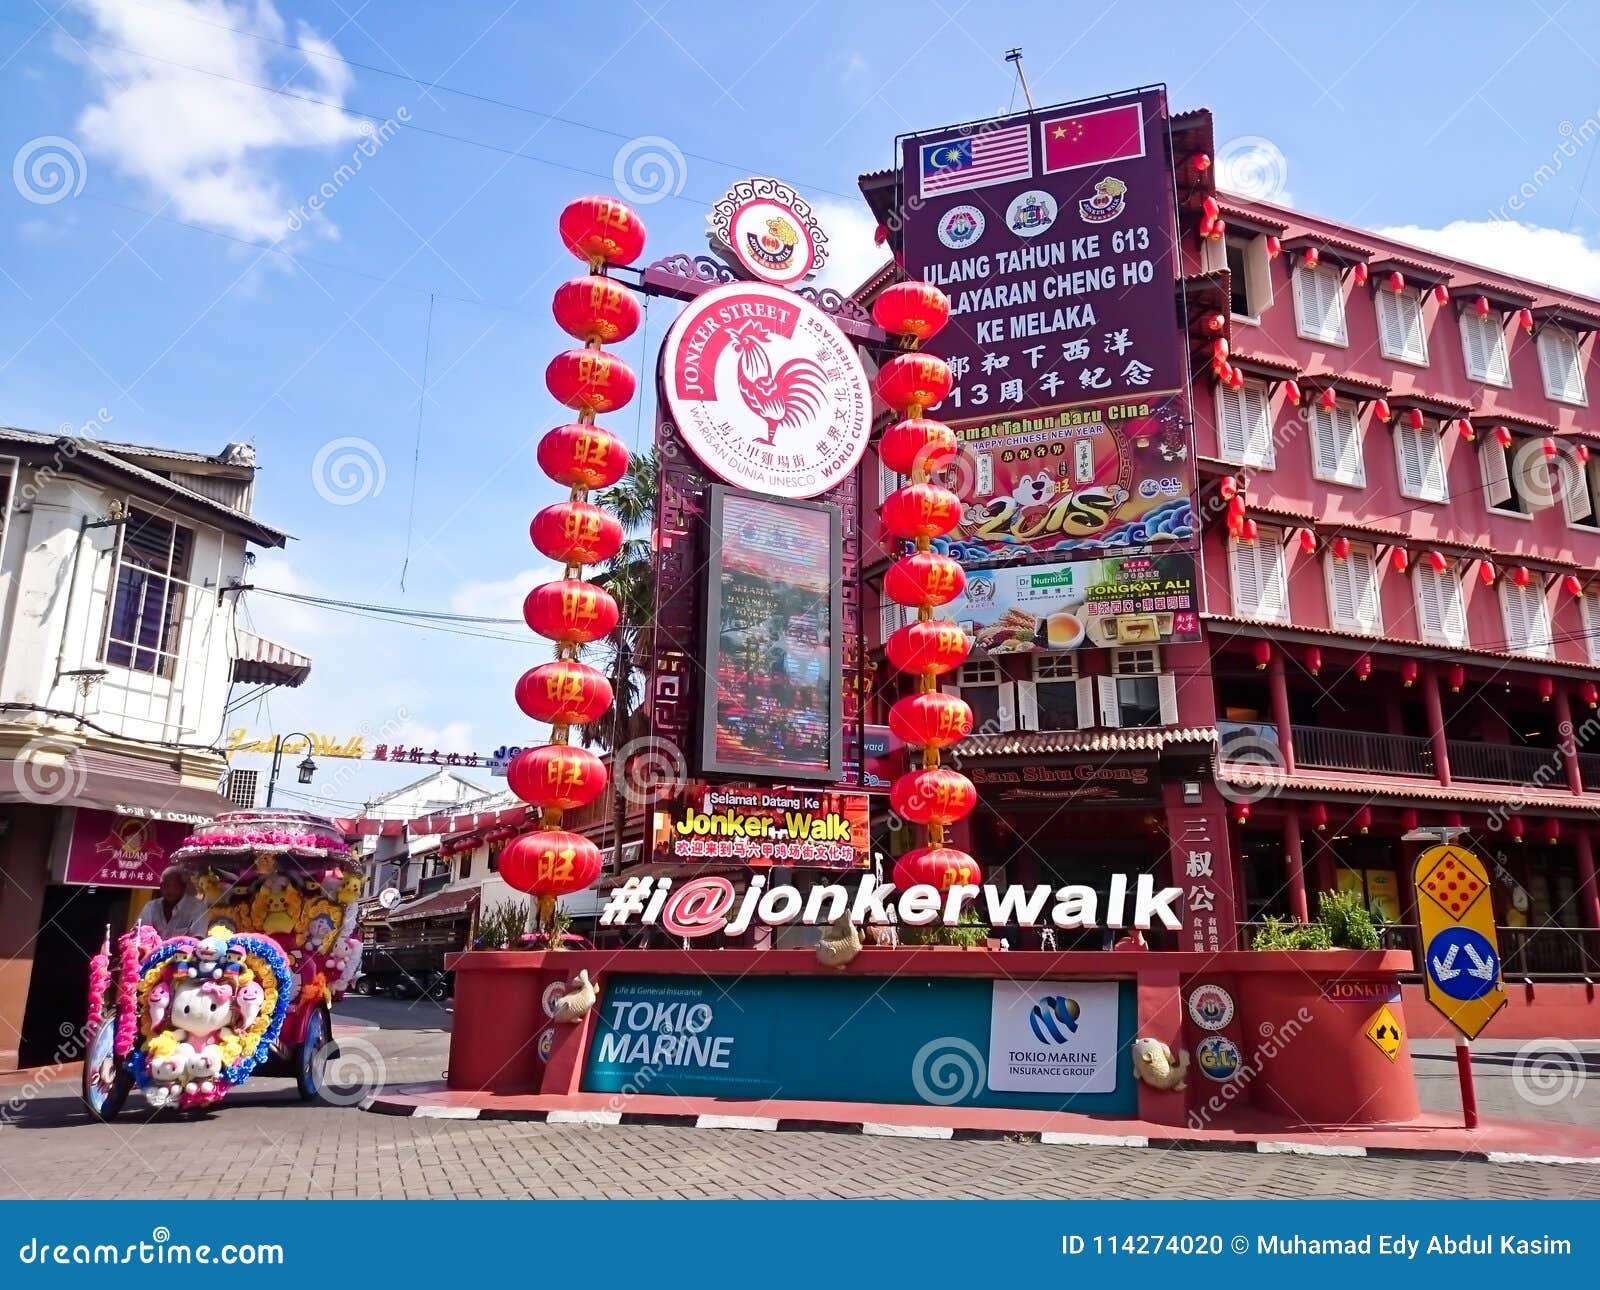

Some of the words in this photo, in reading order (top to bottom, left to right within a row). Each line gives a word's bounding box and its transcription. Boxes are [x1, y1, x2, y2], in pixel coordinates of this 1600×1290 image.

[750, 236, 774, 262] JONKER
[775, 248, 791, 262] WALK
[923, 255, 991, 286] ULANG
[996, 241, 1066, 275] TAHUN
[1072, 235, 1100, 259] KE
[1112, 227, 1150, 253] 613
[946, 280, 1037, 316] LAYARAN
[1043, 266, 1115, 300] CHENG
[1122, 260, 1154, 286] HO
[977, 318, 1004, 344] KE
[1010, 303, 1097, 339] MELAKA
[684, 317, 722, 395] JONKER
[719, 303, 791, 324] STREET
[807, 317, 854, 372] HERITAGE
[926, 359, 1154, 412] 13周年紀念
[851, 375, 865, 439] CULTURAL
[955, 424, 998, 442] amat
[1000, 414, 1055, 433] Tahun
[1061, 408, 1102, 425] Baru
[1109, 403, 1150, 419] Cina
[574, 435, 608, 467] 旺
[689, 406, 729, 461] WARISAN
[728, 457, 766, 486] DUNIA
[768, 475, 816, 488] UNESCO
[972, 439, 1003, 451] HAPPY
[1006, 433, 1048, 446] CHINESE
[1051, 429, 1074, 440] NEW
[1076, 424, 1104, 437] YEAR
[821, 442, 855, 479] WORLD
[1019, 578, 1029, 586] Dr
[1033, 576, 1069, 585] Nutrition
[1085, 582, 1160, 595] TONGKAT
[1165, 580, 1190, 589] ALI
[562, 591, 598, 626] 旺
[547, 671, 584, 702] 旺
[547, 756, 584, 786] 旺
[971, 767, 1020, 784] San
[1022, 765, 1074, 782] Shu
[1074, 764, 1148, 785] Gong
[710, 792, 758, 806] Selamat
[762, 794, 800, 810] Datang
[804, 797, 820, 809] Ke
[676, 807, 774, 837] Jonker
[785, 811, 852, 841] Walk
[538, 850, 575, 882] 旺
[675, 840, 855, 862] 欢迎来到马六甲鸡场街文化坊
[1183, 817, 1216, 912] 三叔公
[599, 873, 1185, 938] #i@jonkerwalk
[614, 986, 629, 995] Life
[637, 986, 666, 996] General
[666, 987, 703, 997] Insurance
[612, 1002, 713, 1033] TOKIO
[598, 1032, 734, 1069] MARINE
[1009, 1051, 1046, 1063] TOKIO
[1049, 1052, 1097, 1063] MARINE
[1201, 1050, 1237, 1068] G.L.
[1009, 1066, 1061, 1076] INSURANCE
[1062, 1067, 1095, 1077] GROUP
